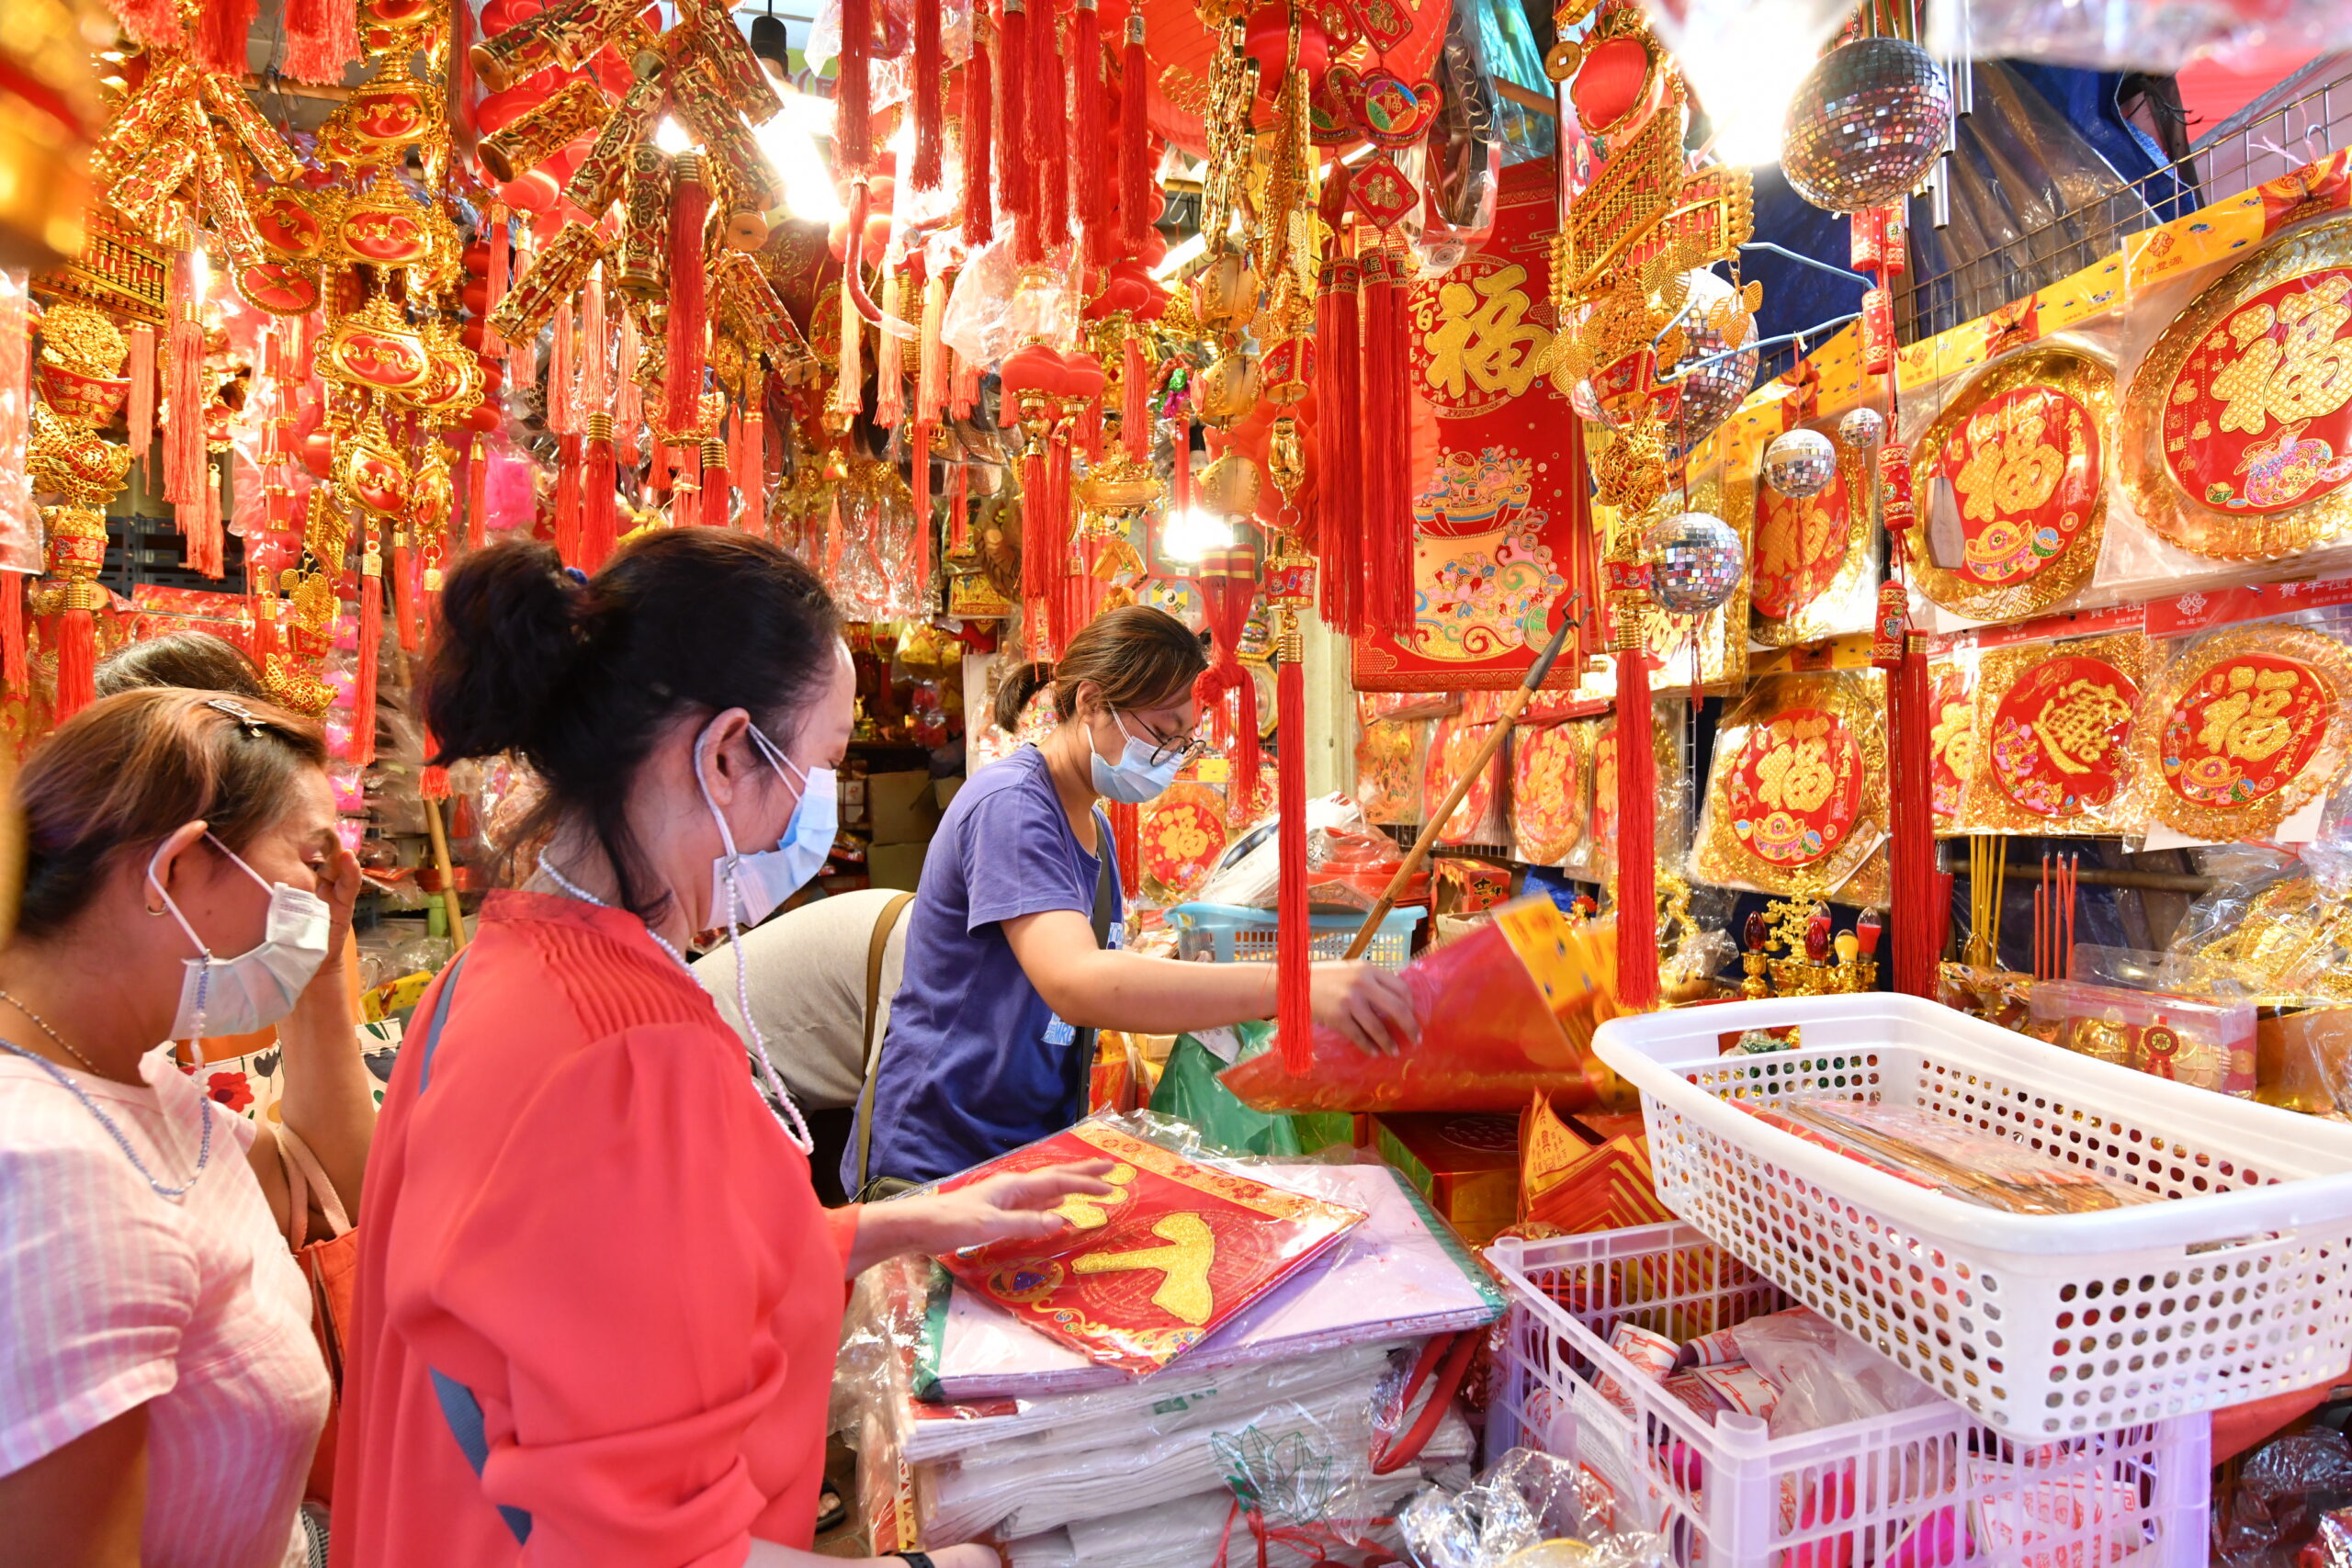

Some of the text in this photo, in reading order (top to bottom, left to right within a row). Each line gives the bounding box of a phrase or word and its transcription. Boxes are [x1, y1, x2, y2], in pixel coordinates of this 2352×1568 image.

[1363, 256, 1382, 274] 福
[1408, 297, 1436, 332] 百
[1424, 265, 1555, 399] 福
[2211, 276, 2352, 435] 福
[1955, 393, 2064, 523] 福
[2198, 666, 2300, 761] 福
[1756, 718, 1836, 812] 福
[1158, 805, 1209, 862] 福
